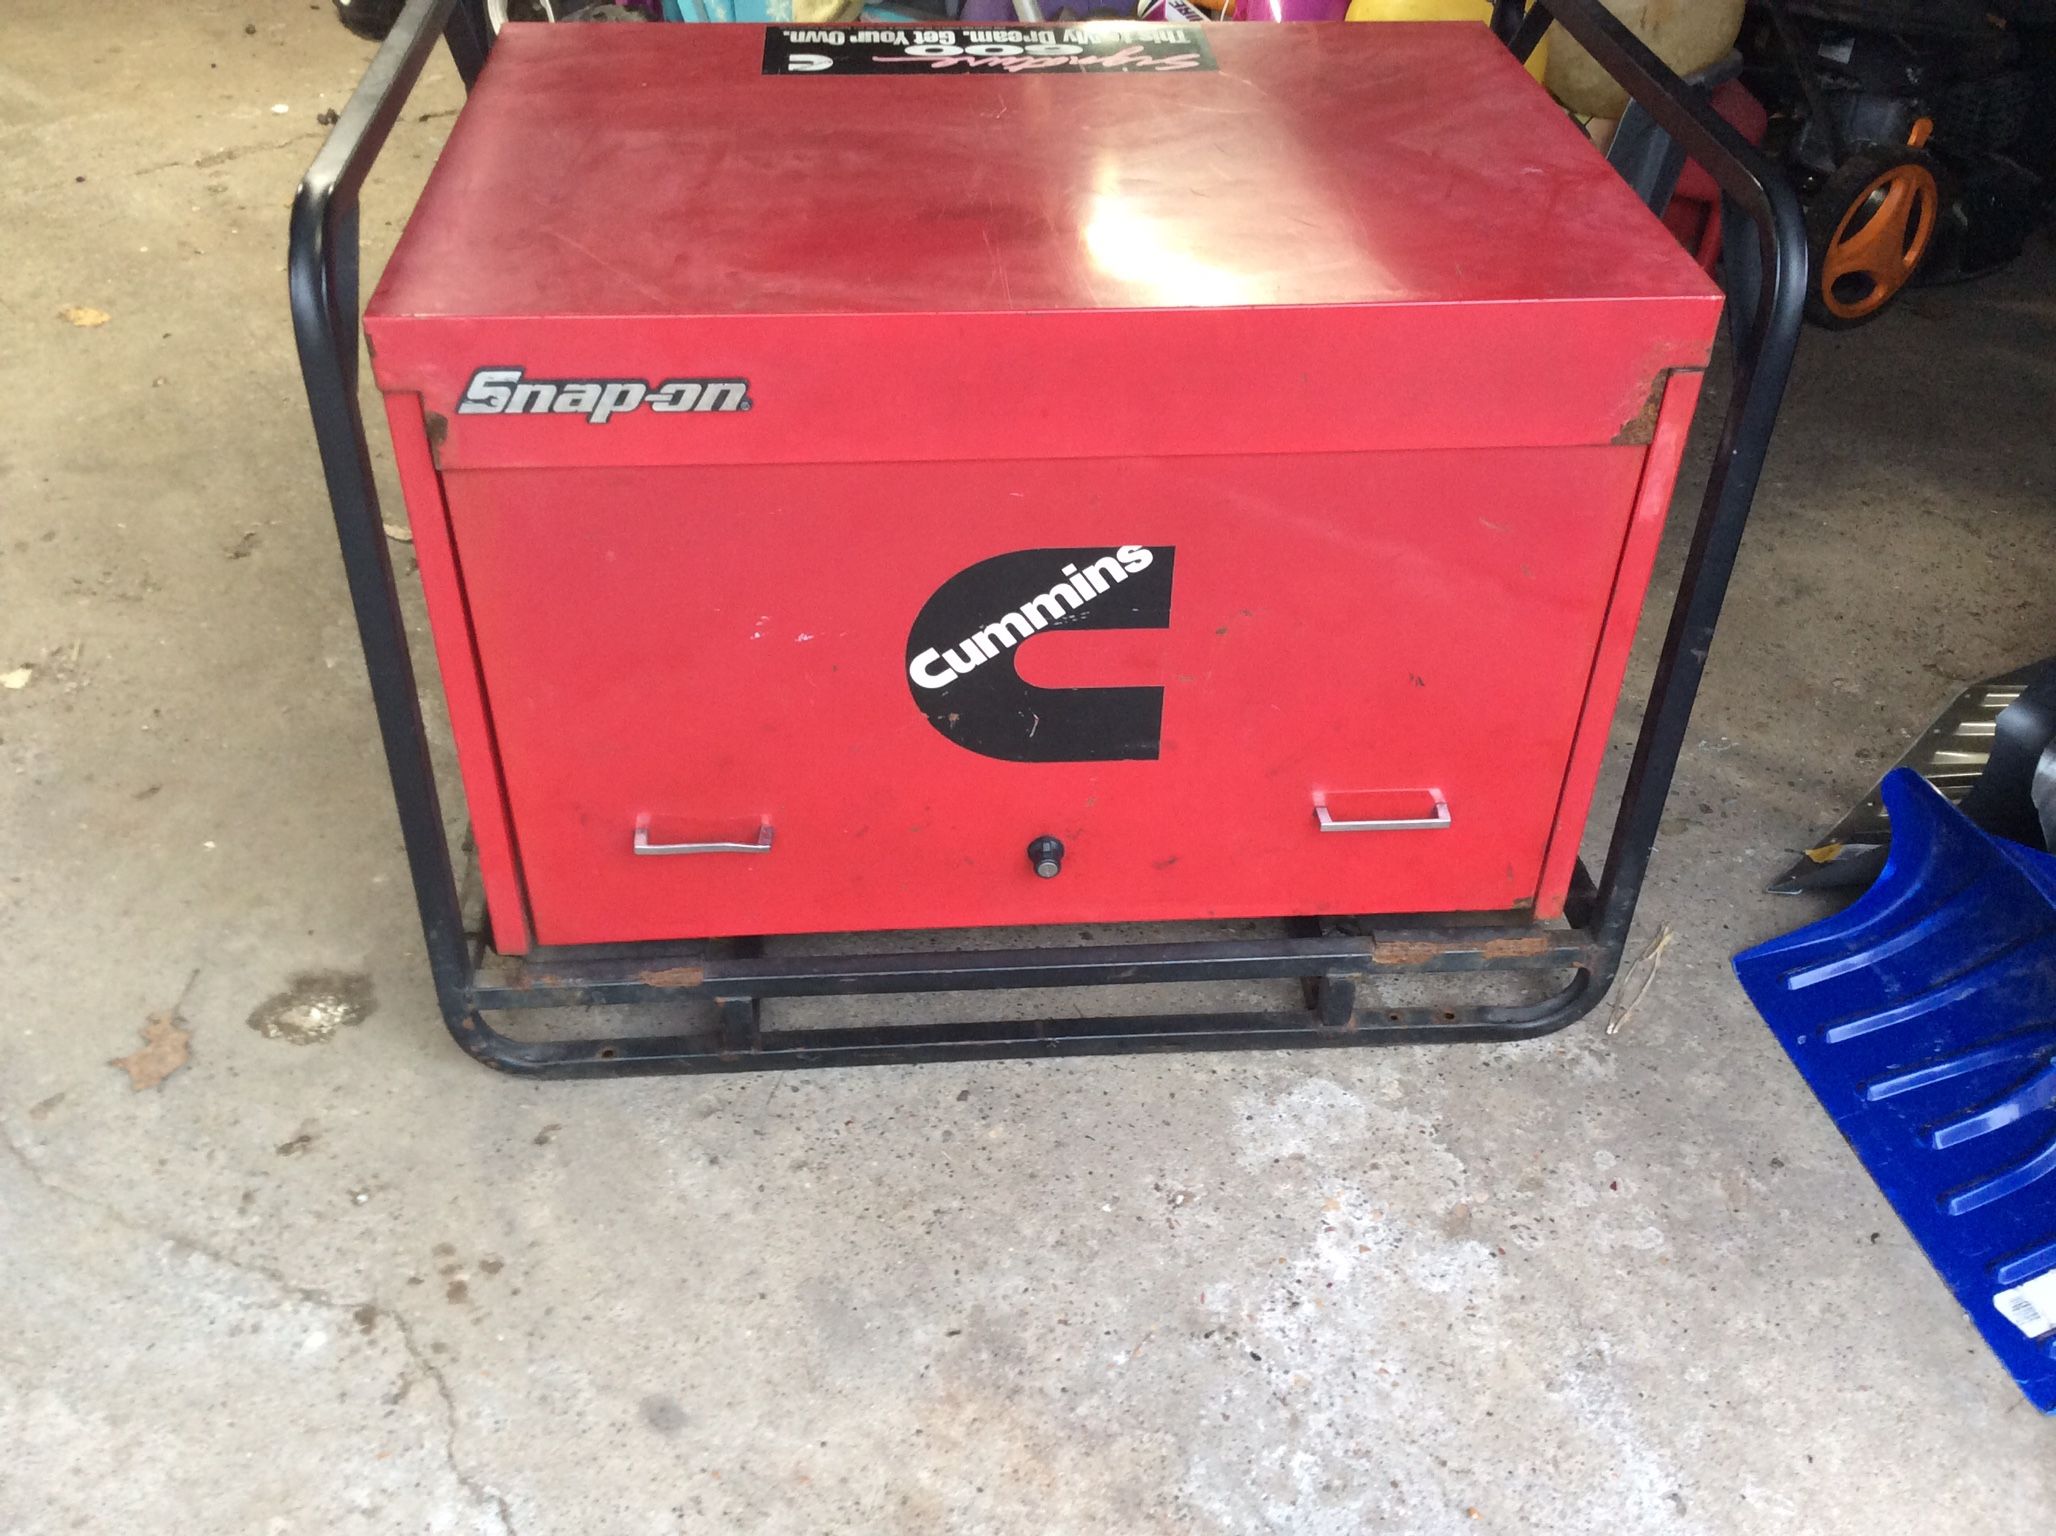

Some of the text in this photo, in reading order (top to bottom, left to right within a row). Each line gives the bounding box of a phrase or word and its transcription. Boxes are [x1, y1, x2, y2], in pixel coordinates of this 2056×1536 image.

[783, 31, 845, 46] Own.
[850, 31, 910, 46] Your
[914, 30, 956, 45] Get
[963, 30, 1057, 45] Dream.
[1143, 29, 1191, 44] This
[872, 45, 1200, 72] Signature
[909, 545, 1154, 689] Cummins
